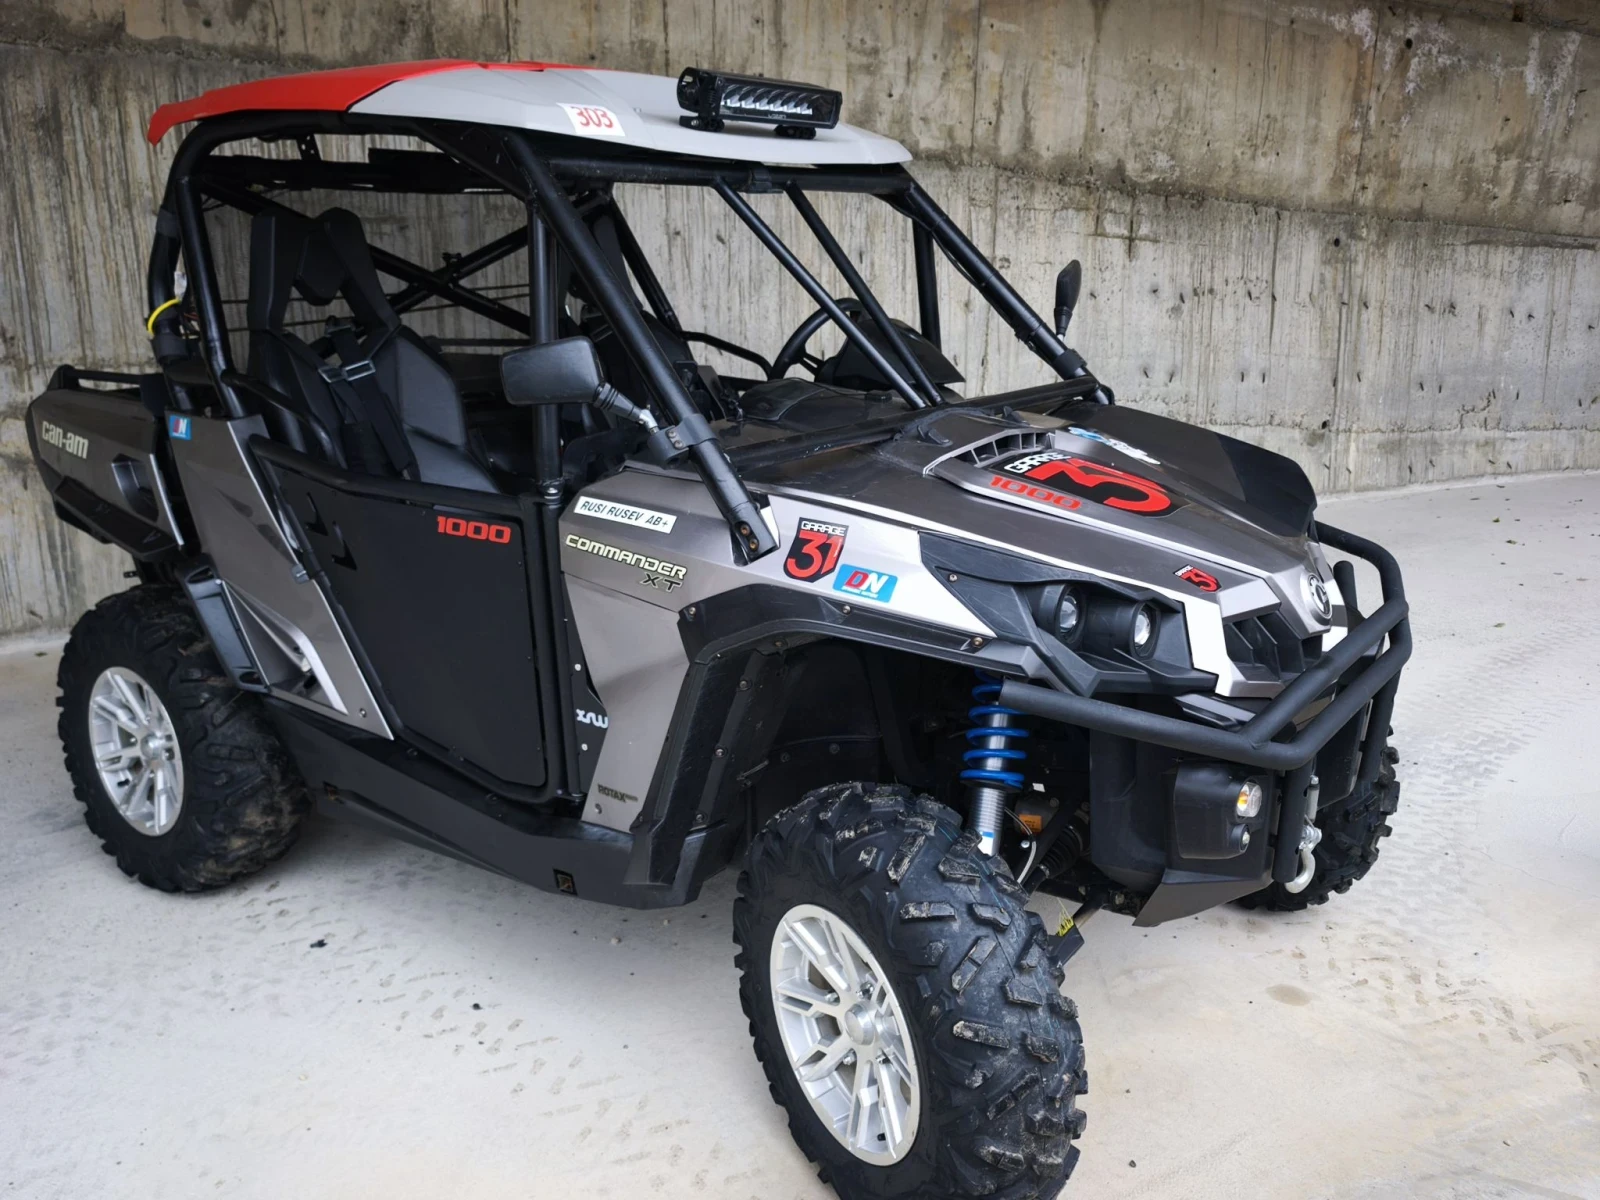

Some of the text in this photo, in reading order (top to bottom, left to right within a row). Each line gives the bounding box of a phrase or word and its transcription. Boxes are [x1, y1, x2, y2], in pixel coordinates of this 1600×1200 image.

[570, 106, 613, 128] 303
[42, 420, 89, 459] can-am
[989, 475, 1083, 511] 1000
[580, 500, 669, 528] RUSI RUSEV AB+
[437, 515, 511, 544] 1000
[801, 520, 846, 537] GARAGE
[565, 534, 687, 580] COMMANDER
[786, 530, 845, 578] 31
[640, 572, 682, 592] XT
[844, 569, 890, 595] DN
